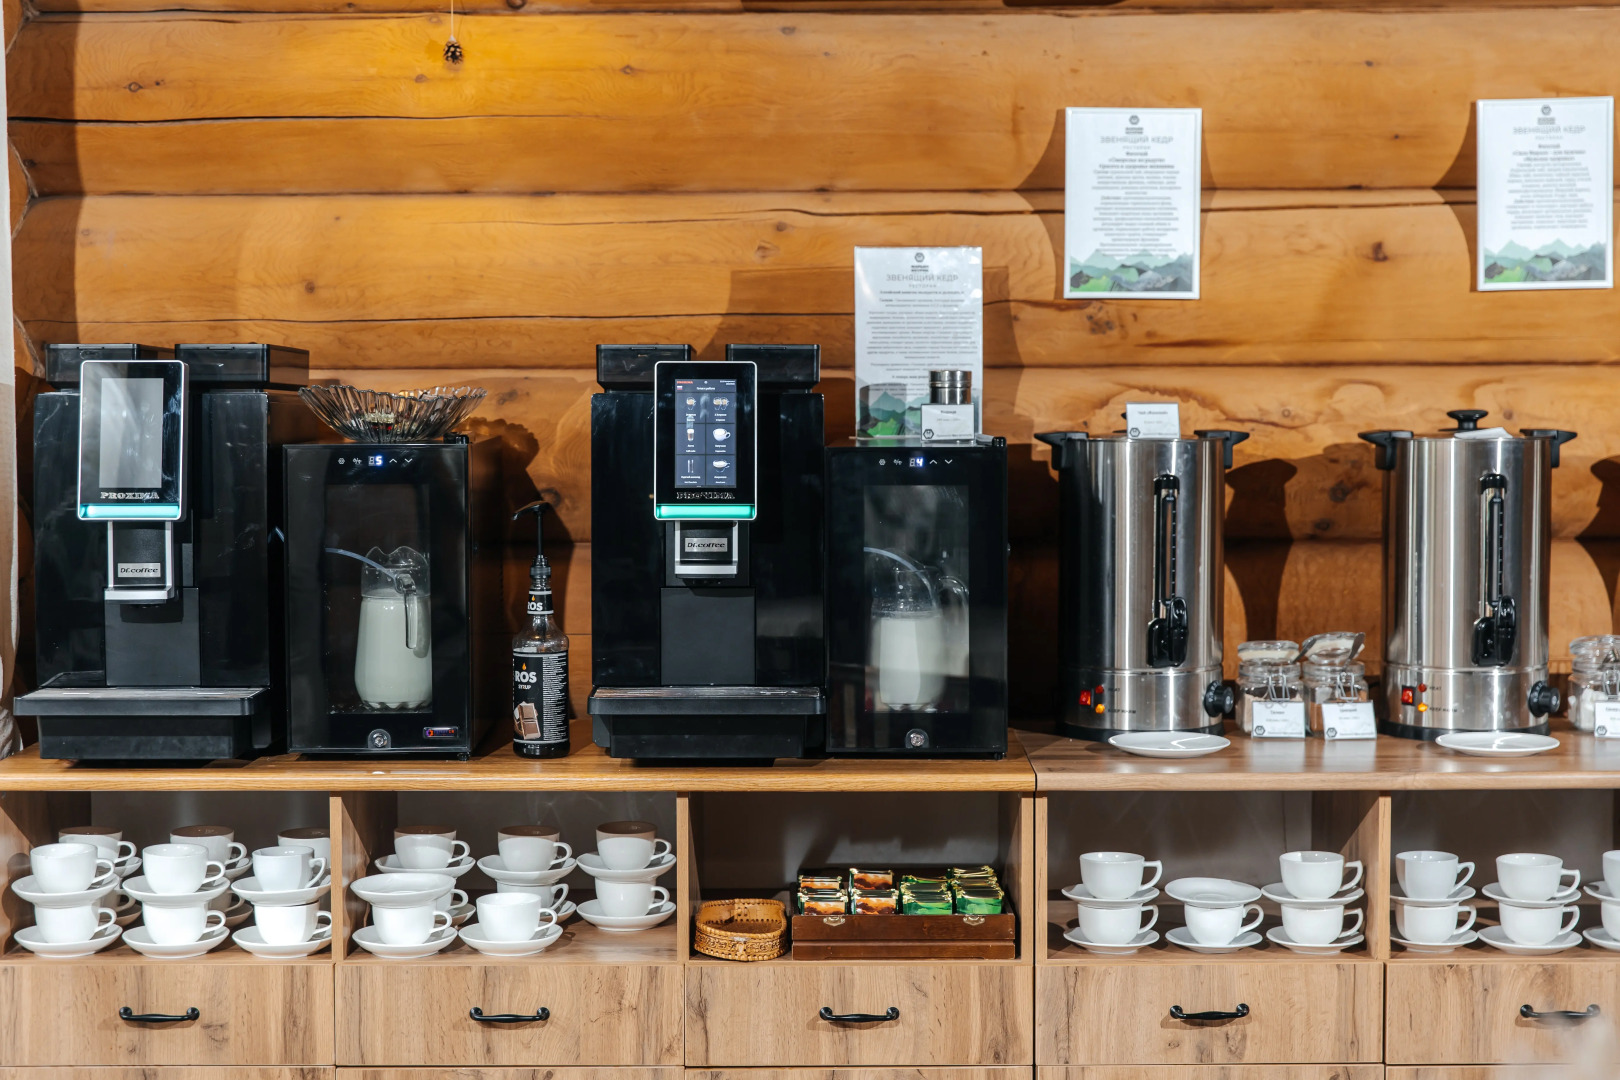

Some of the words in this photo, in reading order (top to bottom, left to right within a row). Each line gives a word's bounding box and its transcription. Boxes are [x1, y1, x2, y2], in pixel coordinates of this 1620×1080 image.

[1151, 136, 1174, 144] КЕДР
[886, 274, 934, 282] ЗВЕНЯЩИЙ
[937, 273, 959, 282] КЕДР
[100, 491, 160, 499] PROXIMA
